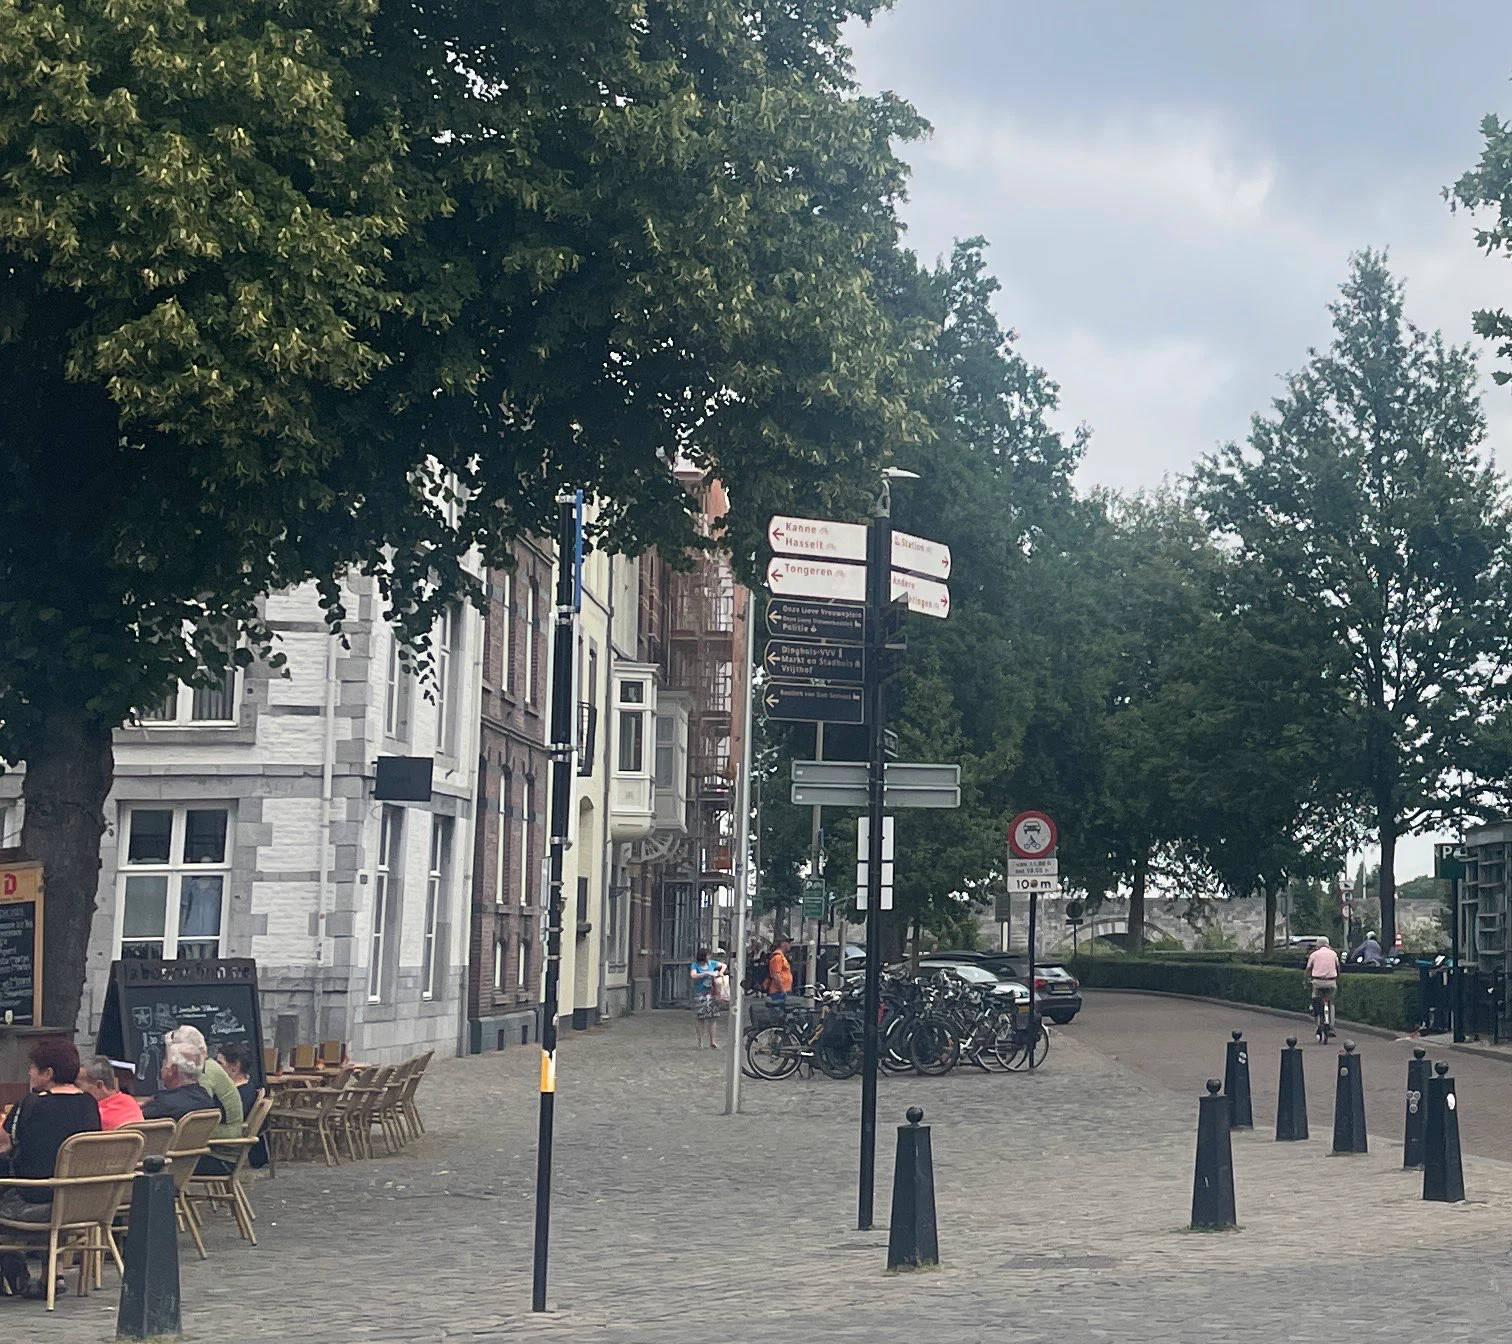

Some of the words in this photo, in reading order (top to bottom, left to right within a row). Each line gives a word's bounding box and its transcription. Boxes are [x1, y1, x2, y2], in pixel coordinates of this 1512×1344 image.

[785, 522, 817, 534] Kanne
[785, 537, 823, 550] Hasselt
[784, 563, 833, 577] Tongeren
